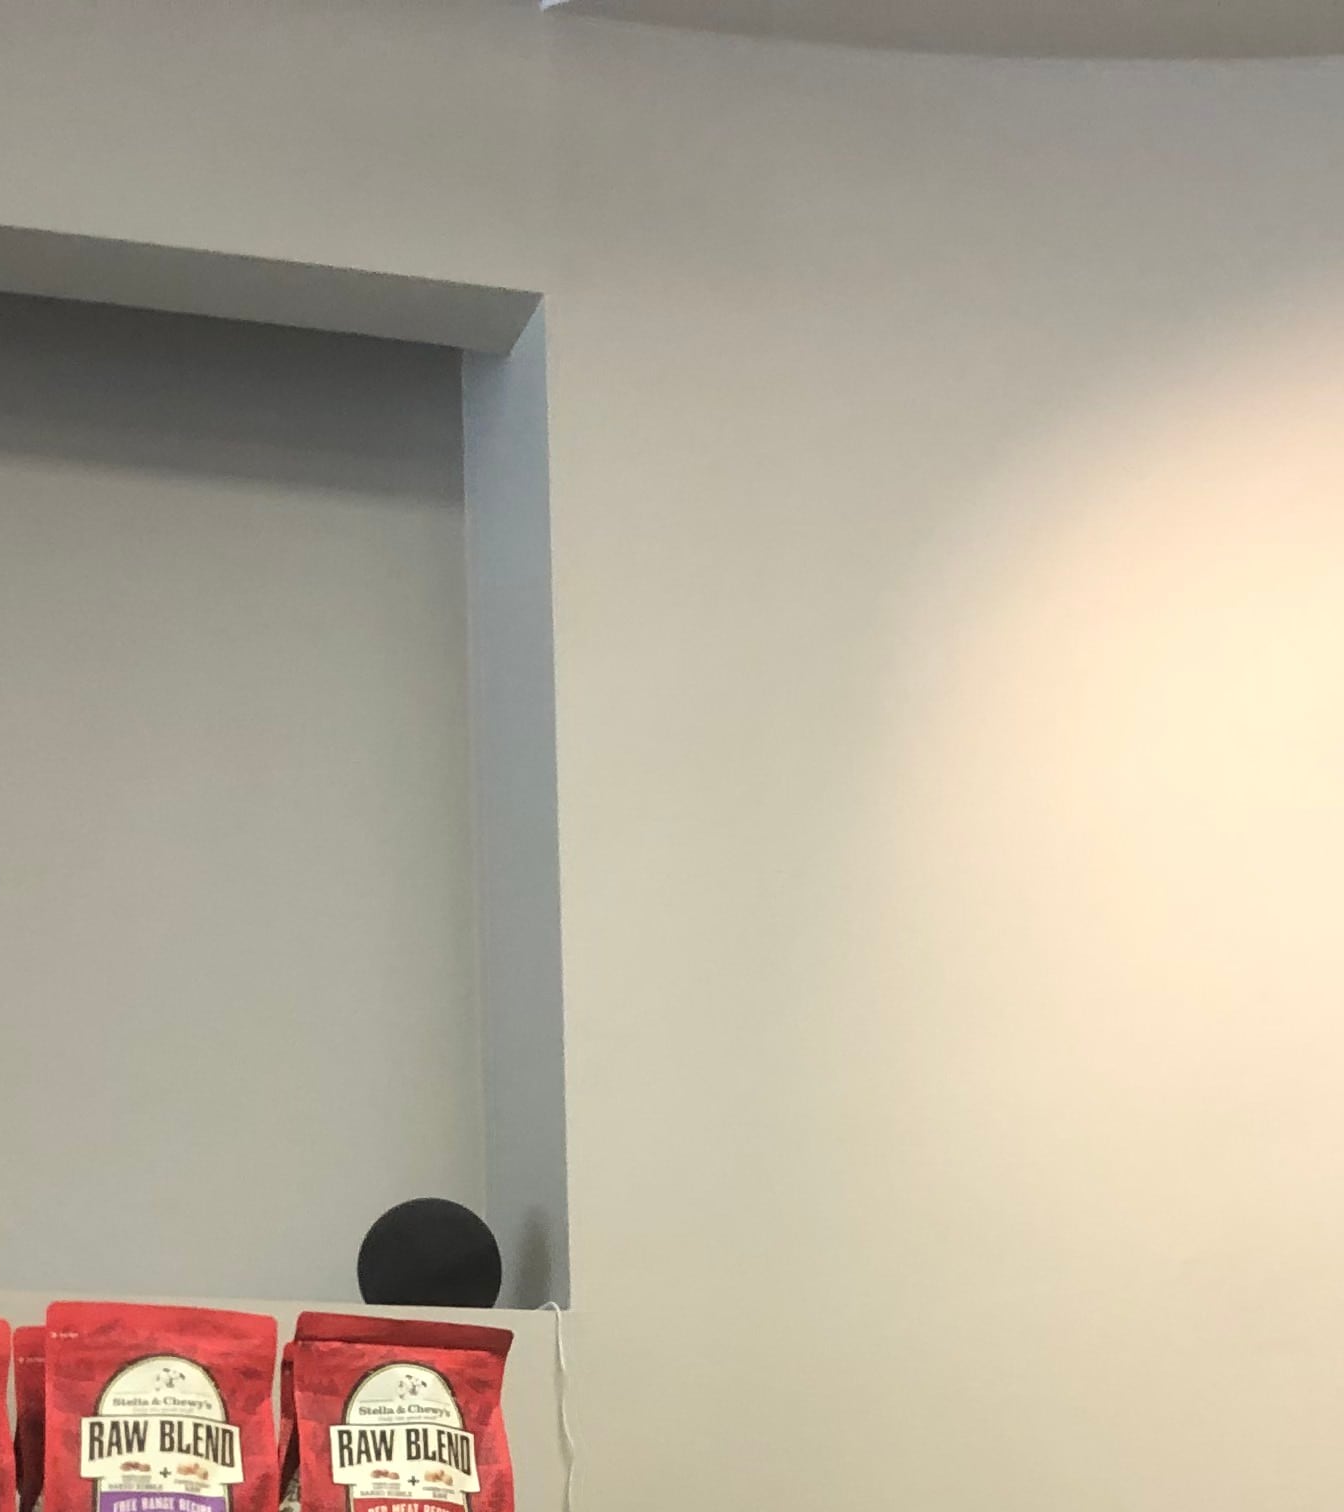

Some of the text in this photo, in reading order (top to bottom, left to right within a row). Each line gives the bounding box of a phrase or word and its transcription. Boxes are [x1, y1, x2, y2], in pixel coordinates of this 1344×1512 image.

[396, 1405, 406, 1415] &
[88, 1419, 235, 1468] RAW BLEND
[337, 1428, 472, 1477] RAW BLEND
[141, 1496, 175, 1511] RANGE
